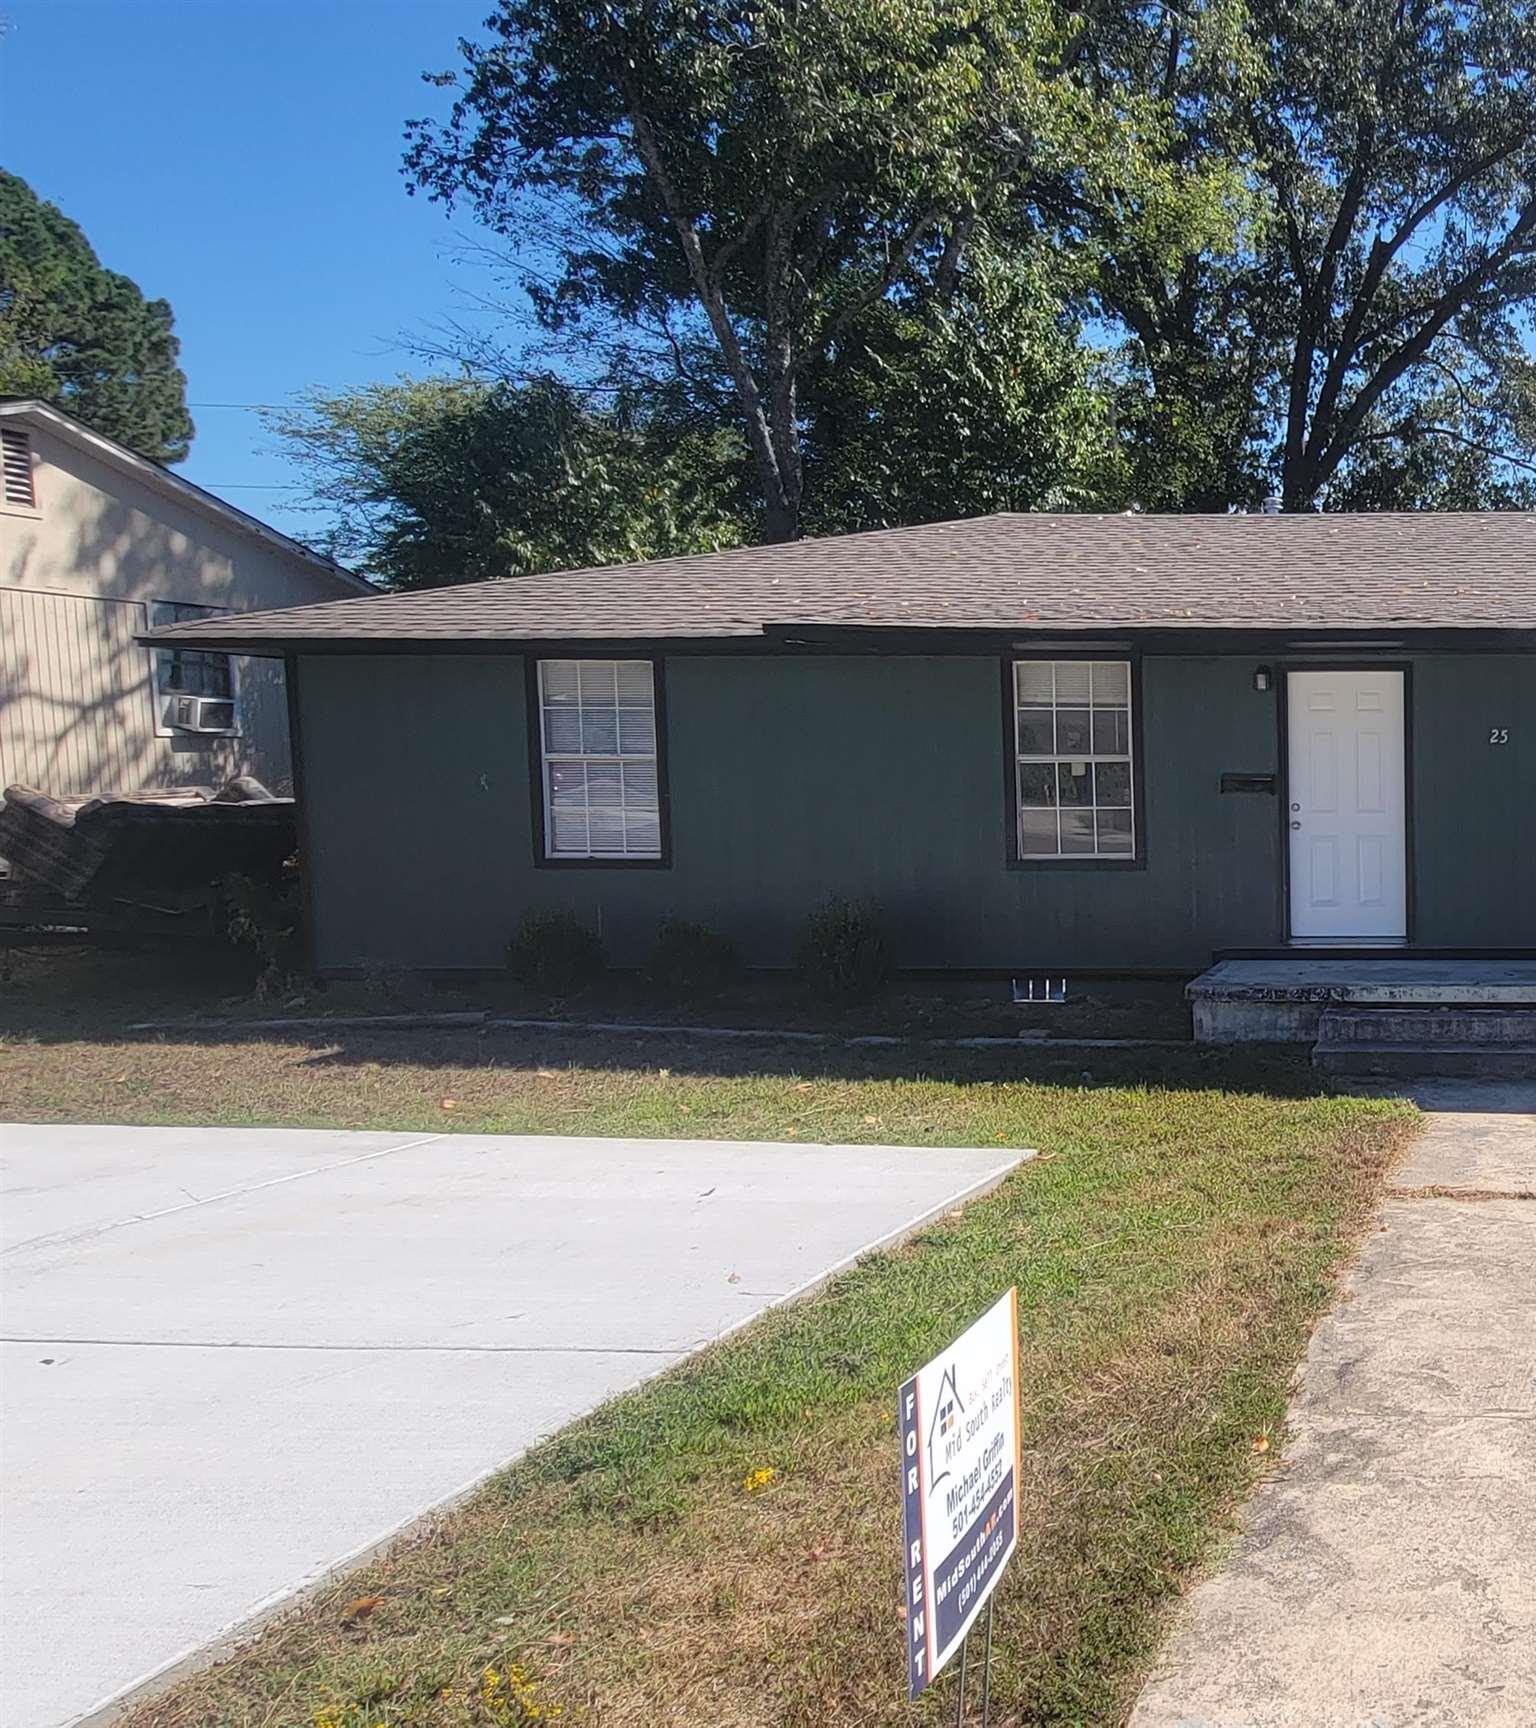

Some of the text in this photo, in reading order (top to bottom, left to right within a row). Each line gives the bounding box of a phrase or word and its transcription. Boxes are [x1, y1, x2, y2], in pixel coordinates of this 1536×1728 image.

[1489, 729, 1508, 744] 25
[945, 1376, 1012, 1464] Mid South Realty
[947, 1456, 981, 1517] Michael
[906, 1393, 925, 1676] FOR RENT
[937, 1488, 1013, 1605] MidSouthAR.com
[959, 1573, 977, 1613] (501)
